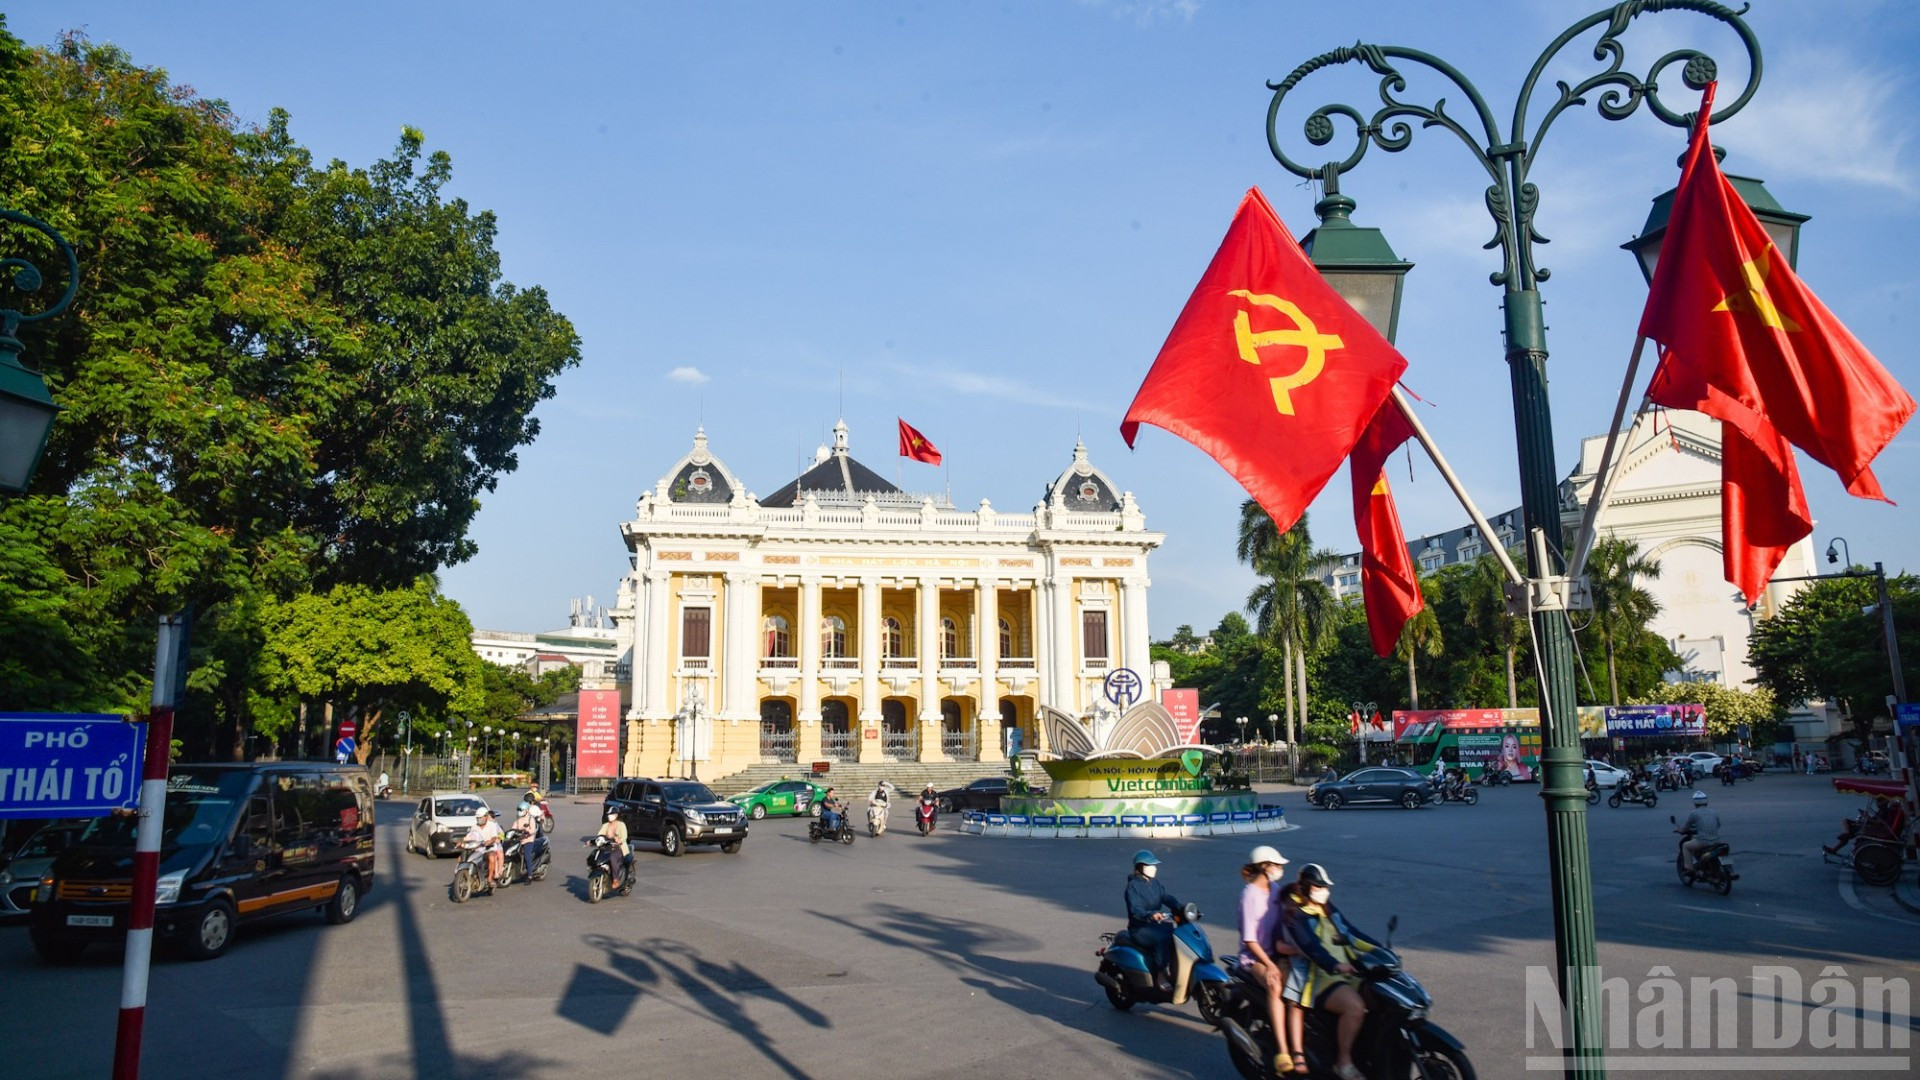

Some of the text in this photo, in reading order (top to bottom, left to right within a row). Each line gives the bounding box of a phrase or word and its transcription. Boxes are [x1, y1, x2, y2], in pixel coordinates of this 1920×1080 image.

[25, 724, 92, 748] PHỐ
[0, 753, 128, 801] THÁI TỔ
[1089, 766, 1102, 774] HÀ
[1103, 766, 1120, 775] NỘI
[1128, 766, 1145, 775] HỘI
